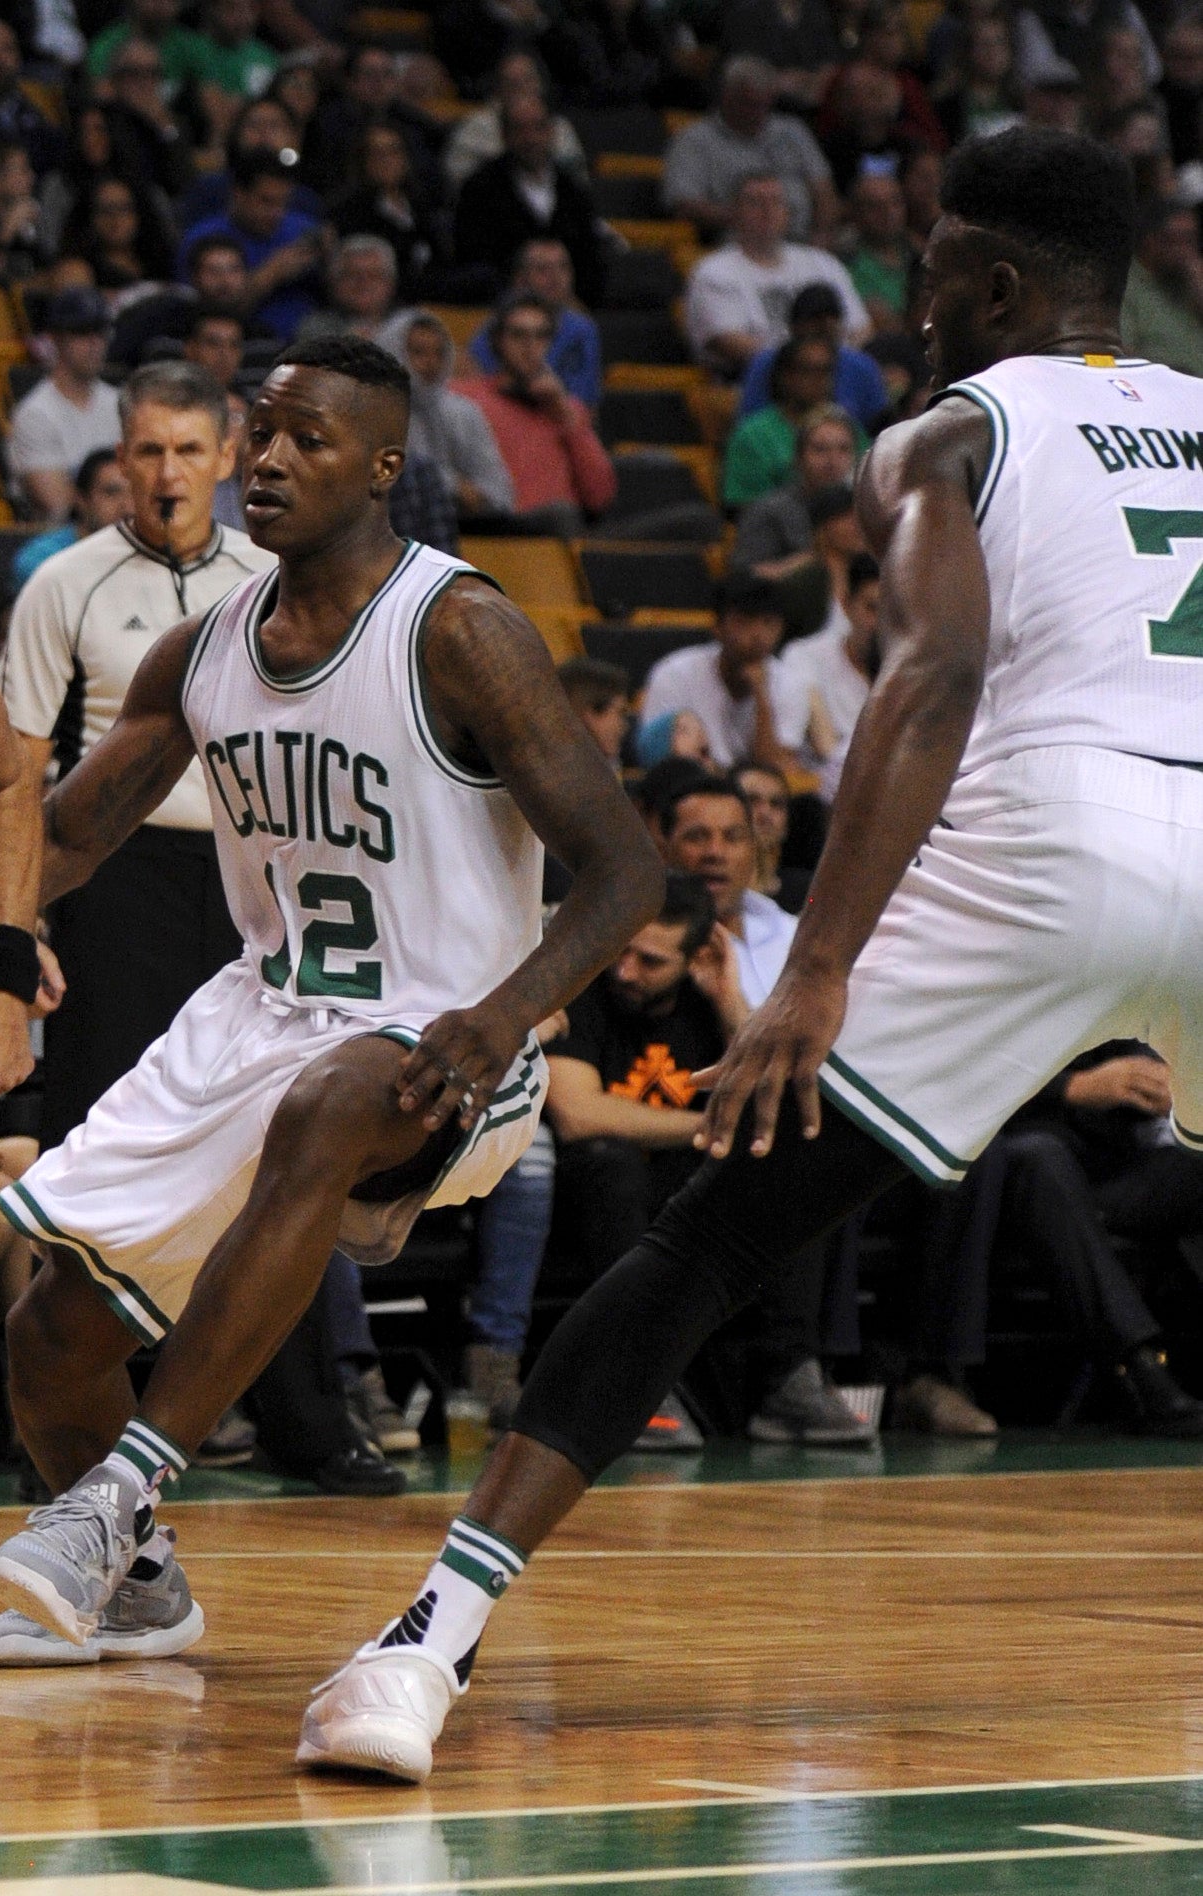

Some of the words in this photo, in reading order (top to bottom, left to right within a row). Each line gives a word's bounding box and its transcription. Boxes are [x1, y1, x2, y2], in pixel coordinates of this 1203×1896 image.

[1121, 506, 1203, 659] 7
[205, 730, 396, 864] CELTICS
[81, 1488, 121, 1518] adidas
